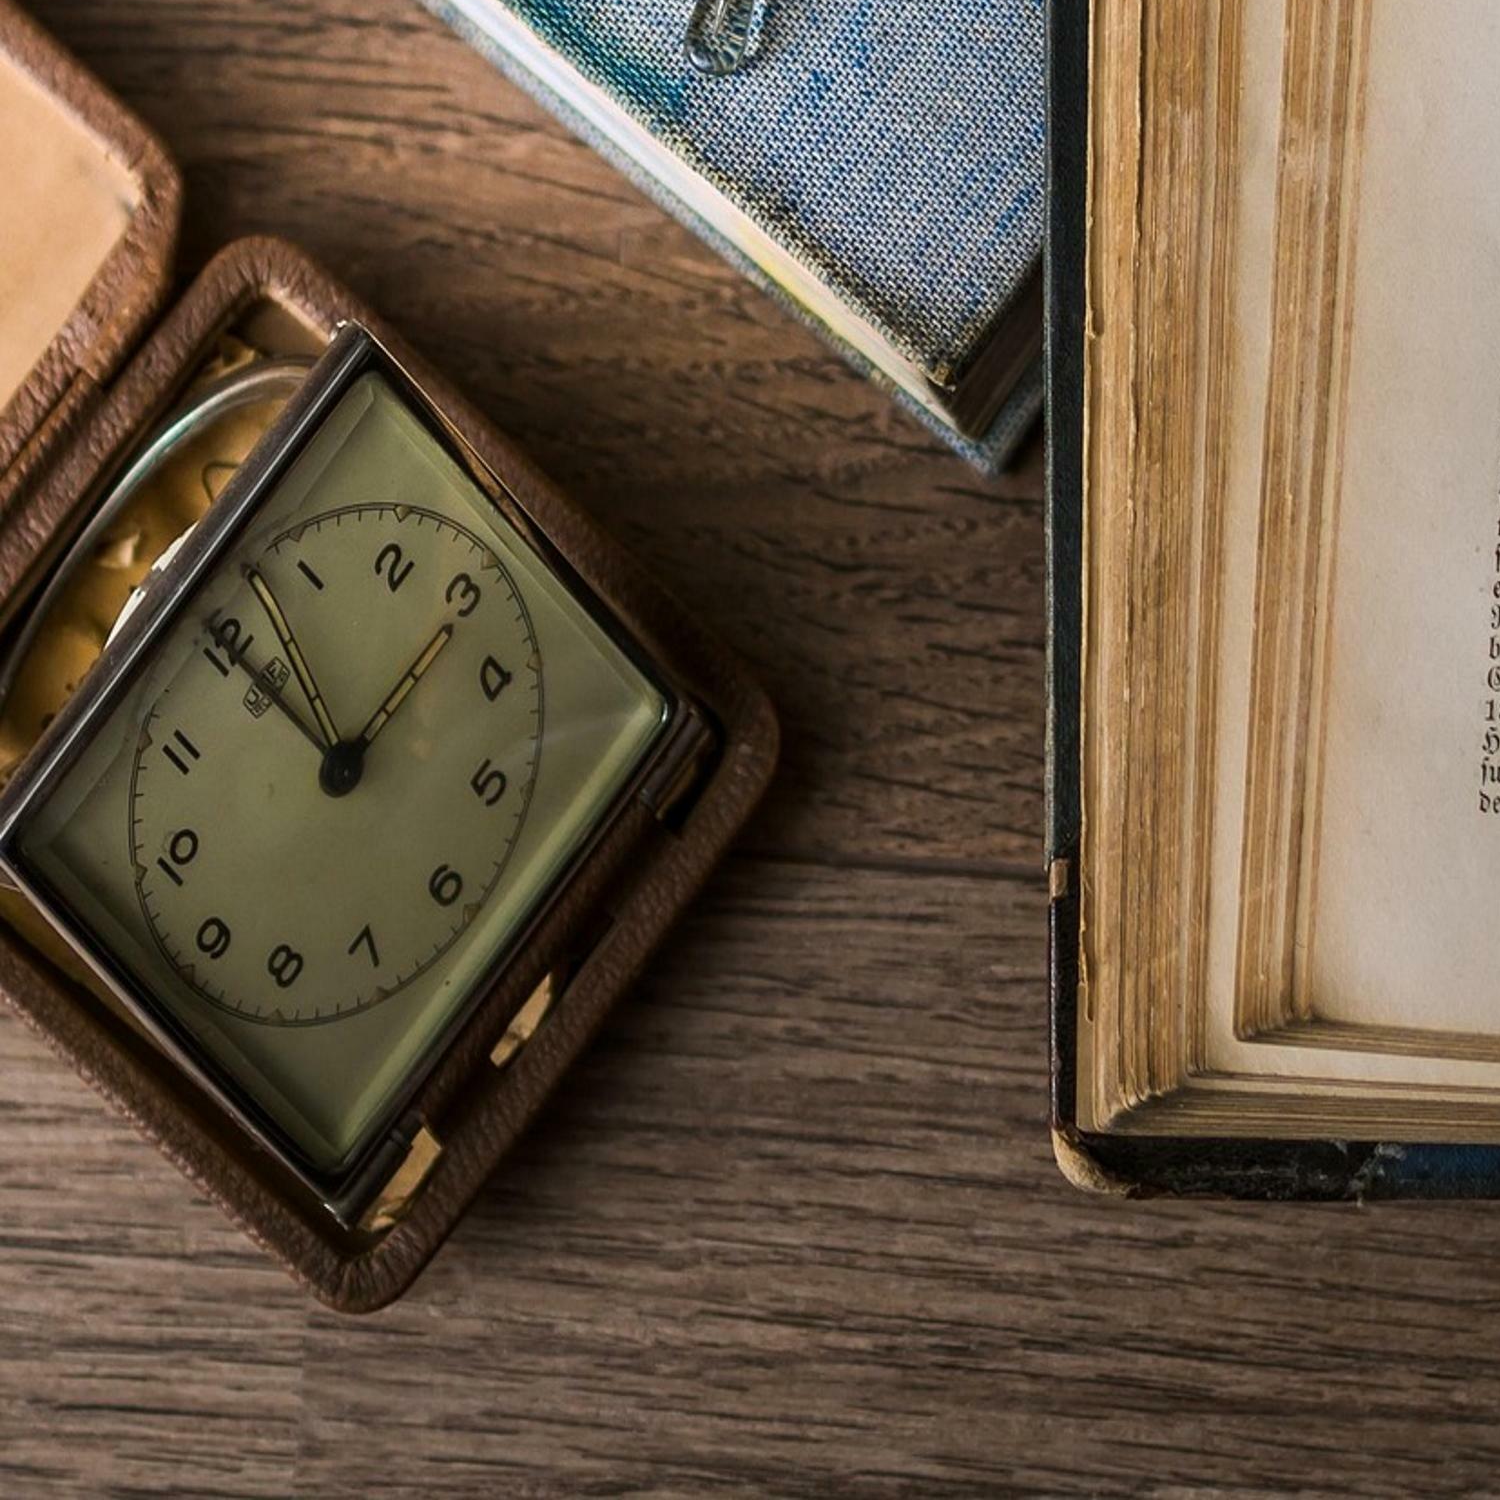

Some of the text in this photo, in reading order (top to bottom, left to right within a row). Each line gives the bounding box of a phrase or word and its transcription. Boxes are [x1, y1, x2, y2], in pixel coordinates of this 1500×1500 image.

[297, 559, 324, 591] 1
[375, 543, 415, 592] 2
[445, 573, 481, 618] 3
[203, 617, 254, 677] 12
[480, 655, 512, 702] 4
[162, 729, 200, 775] 11
[470, 758, 507, 807] 5
[157, 829, 199, 887] 10
[429, 864, 463, 906] 6
[196, 917, 231, 959] 9
[348, 924, 380, 967] 7
[268, 944, 304, 988] 8
